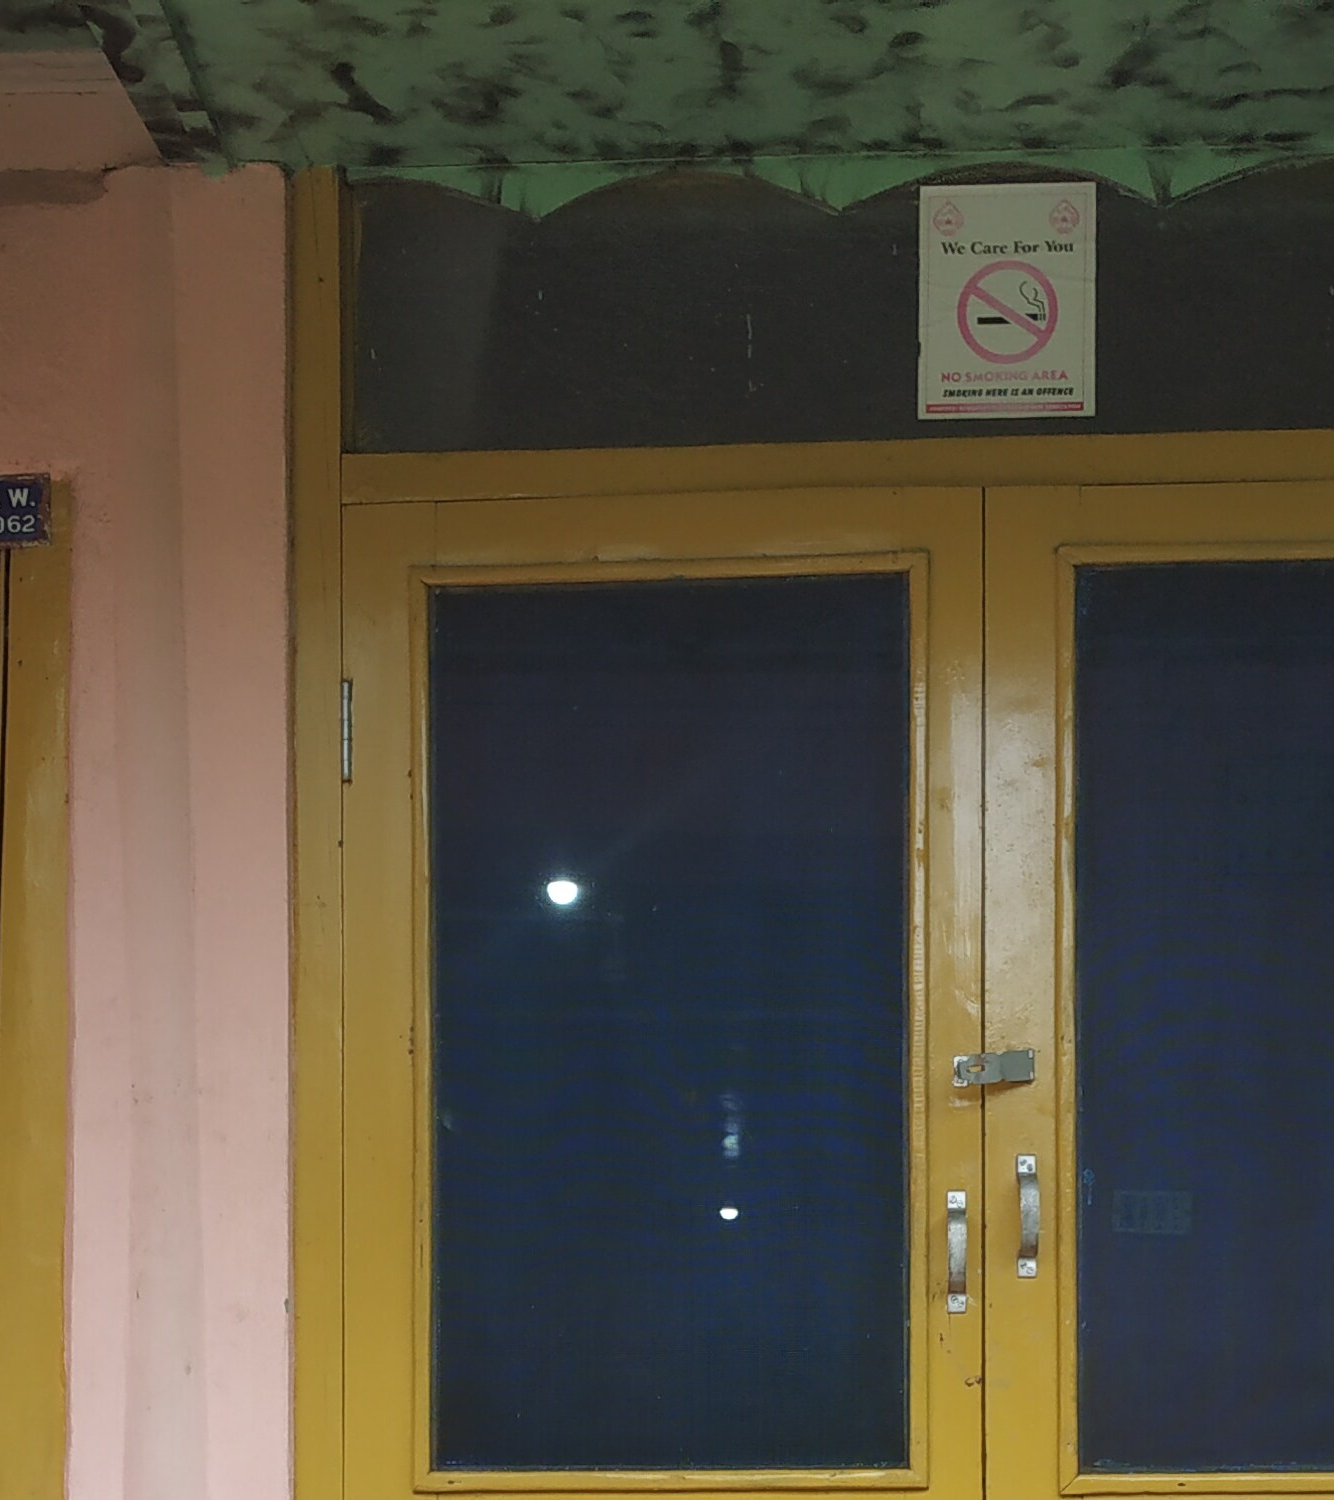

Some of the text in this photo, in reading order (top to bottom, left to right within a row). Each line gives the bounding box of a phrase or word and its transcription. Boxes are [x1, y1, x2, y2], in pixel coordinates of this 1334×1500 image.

[941, 240, 1074, 255] We Care For You
[941, 369, 1069, 383] NO SMOKING AREA
[942, 386, 1075, 398] SMOKING HERE IS AN OFFENCE
